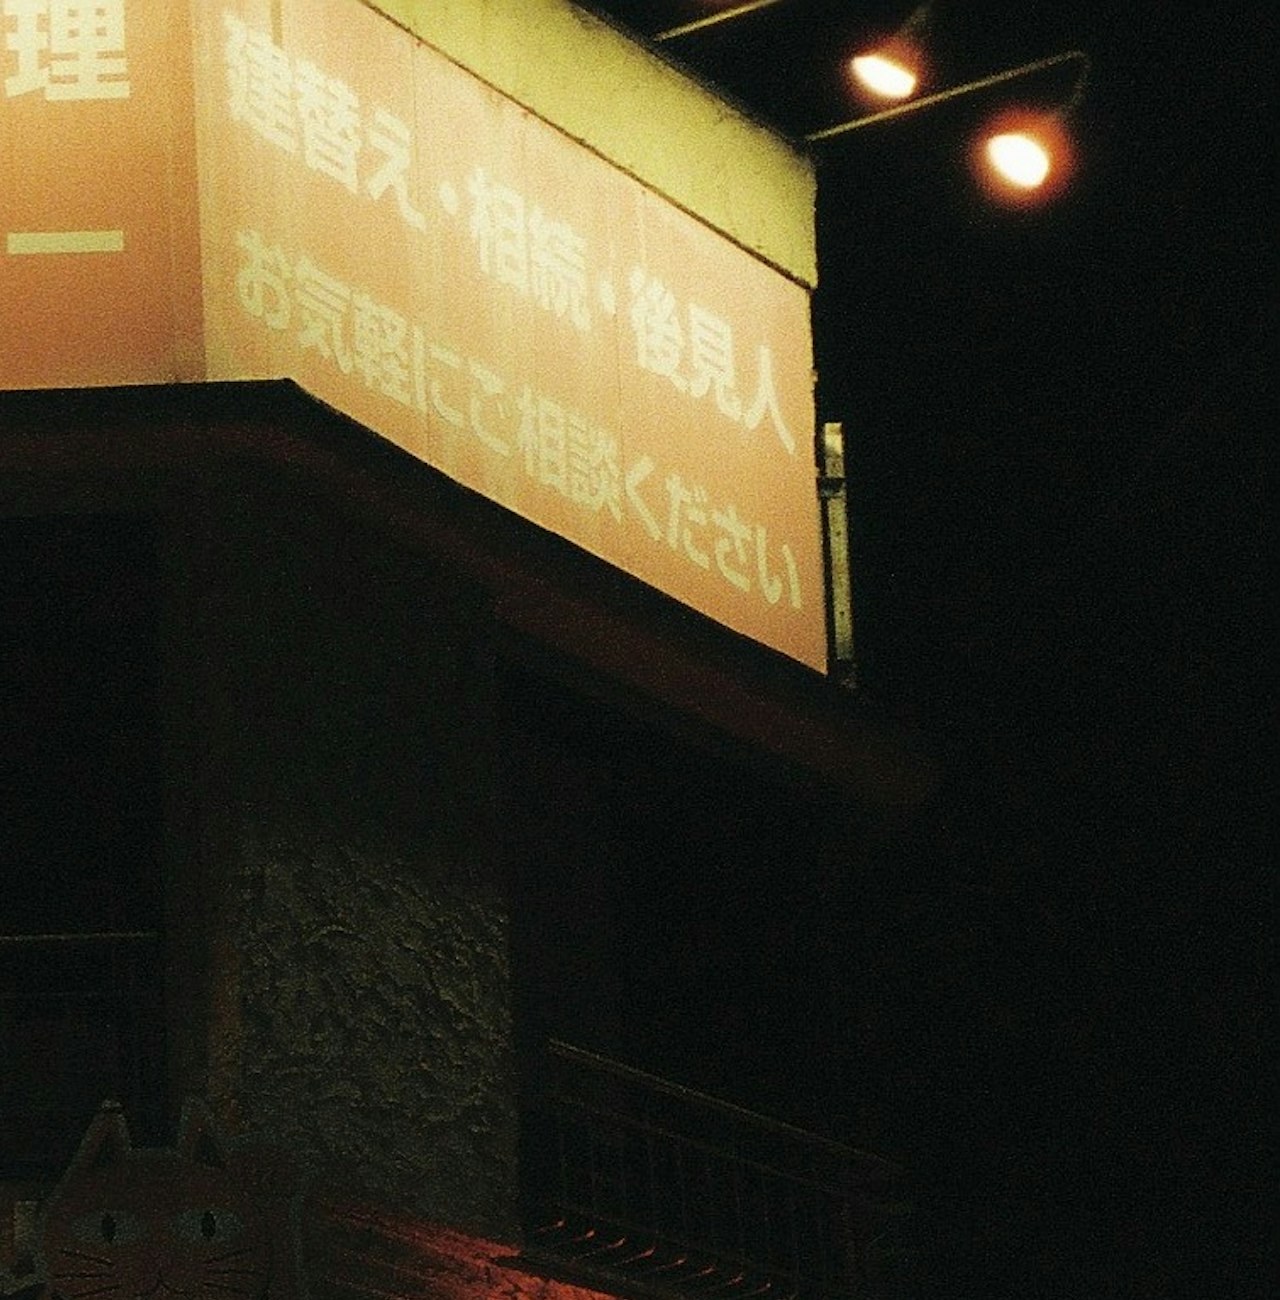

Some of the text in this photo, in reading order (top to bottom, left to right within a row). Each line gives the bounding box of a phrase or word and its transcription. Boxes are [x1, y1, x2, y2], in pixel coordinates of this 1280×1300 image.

[225, 14, 797, 456] 建替え・相続・後見人
[237, 229, 802, 610] お気軽にご相談ください
